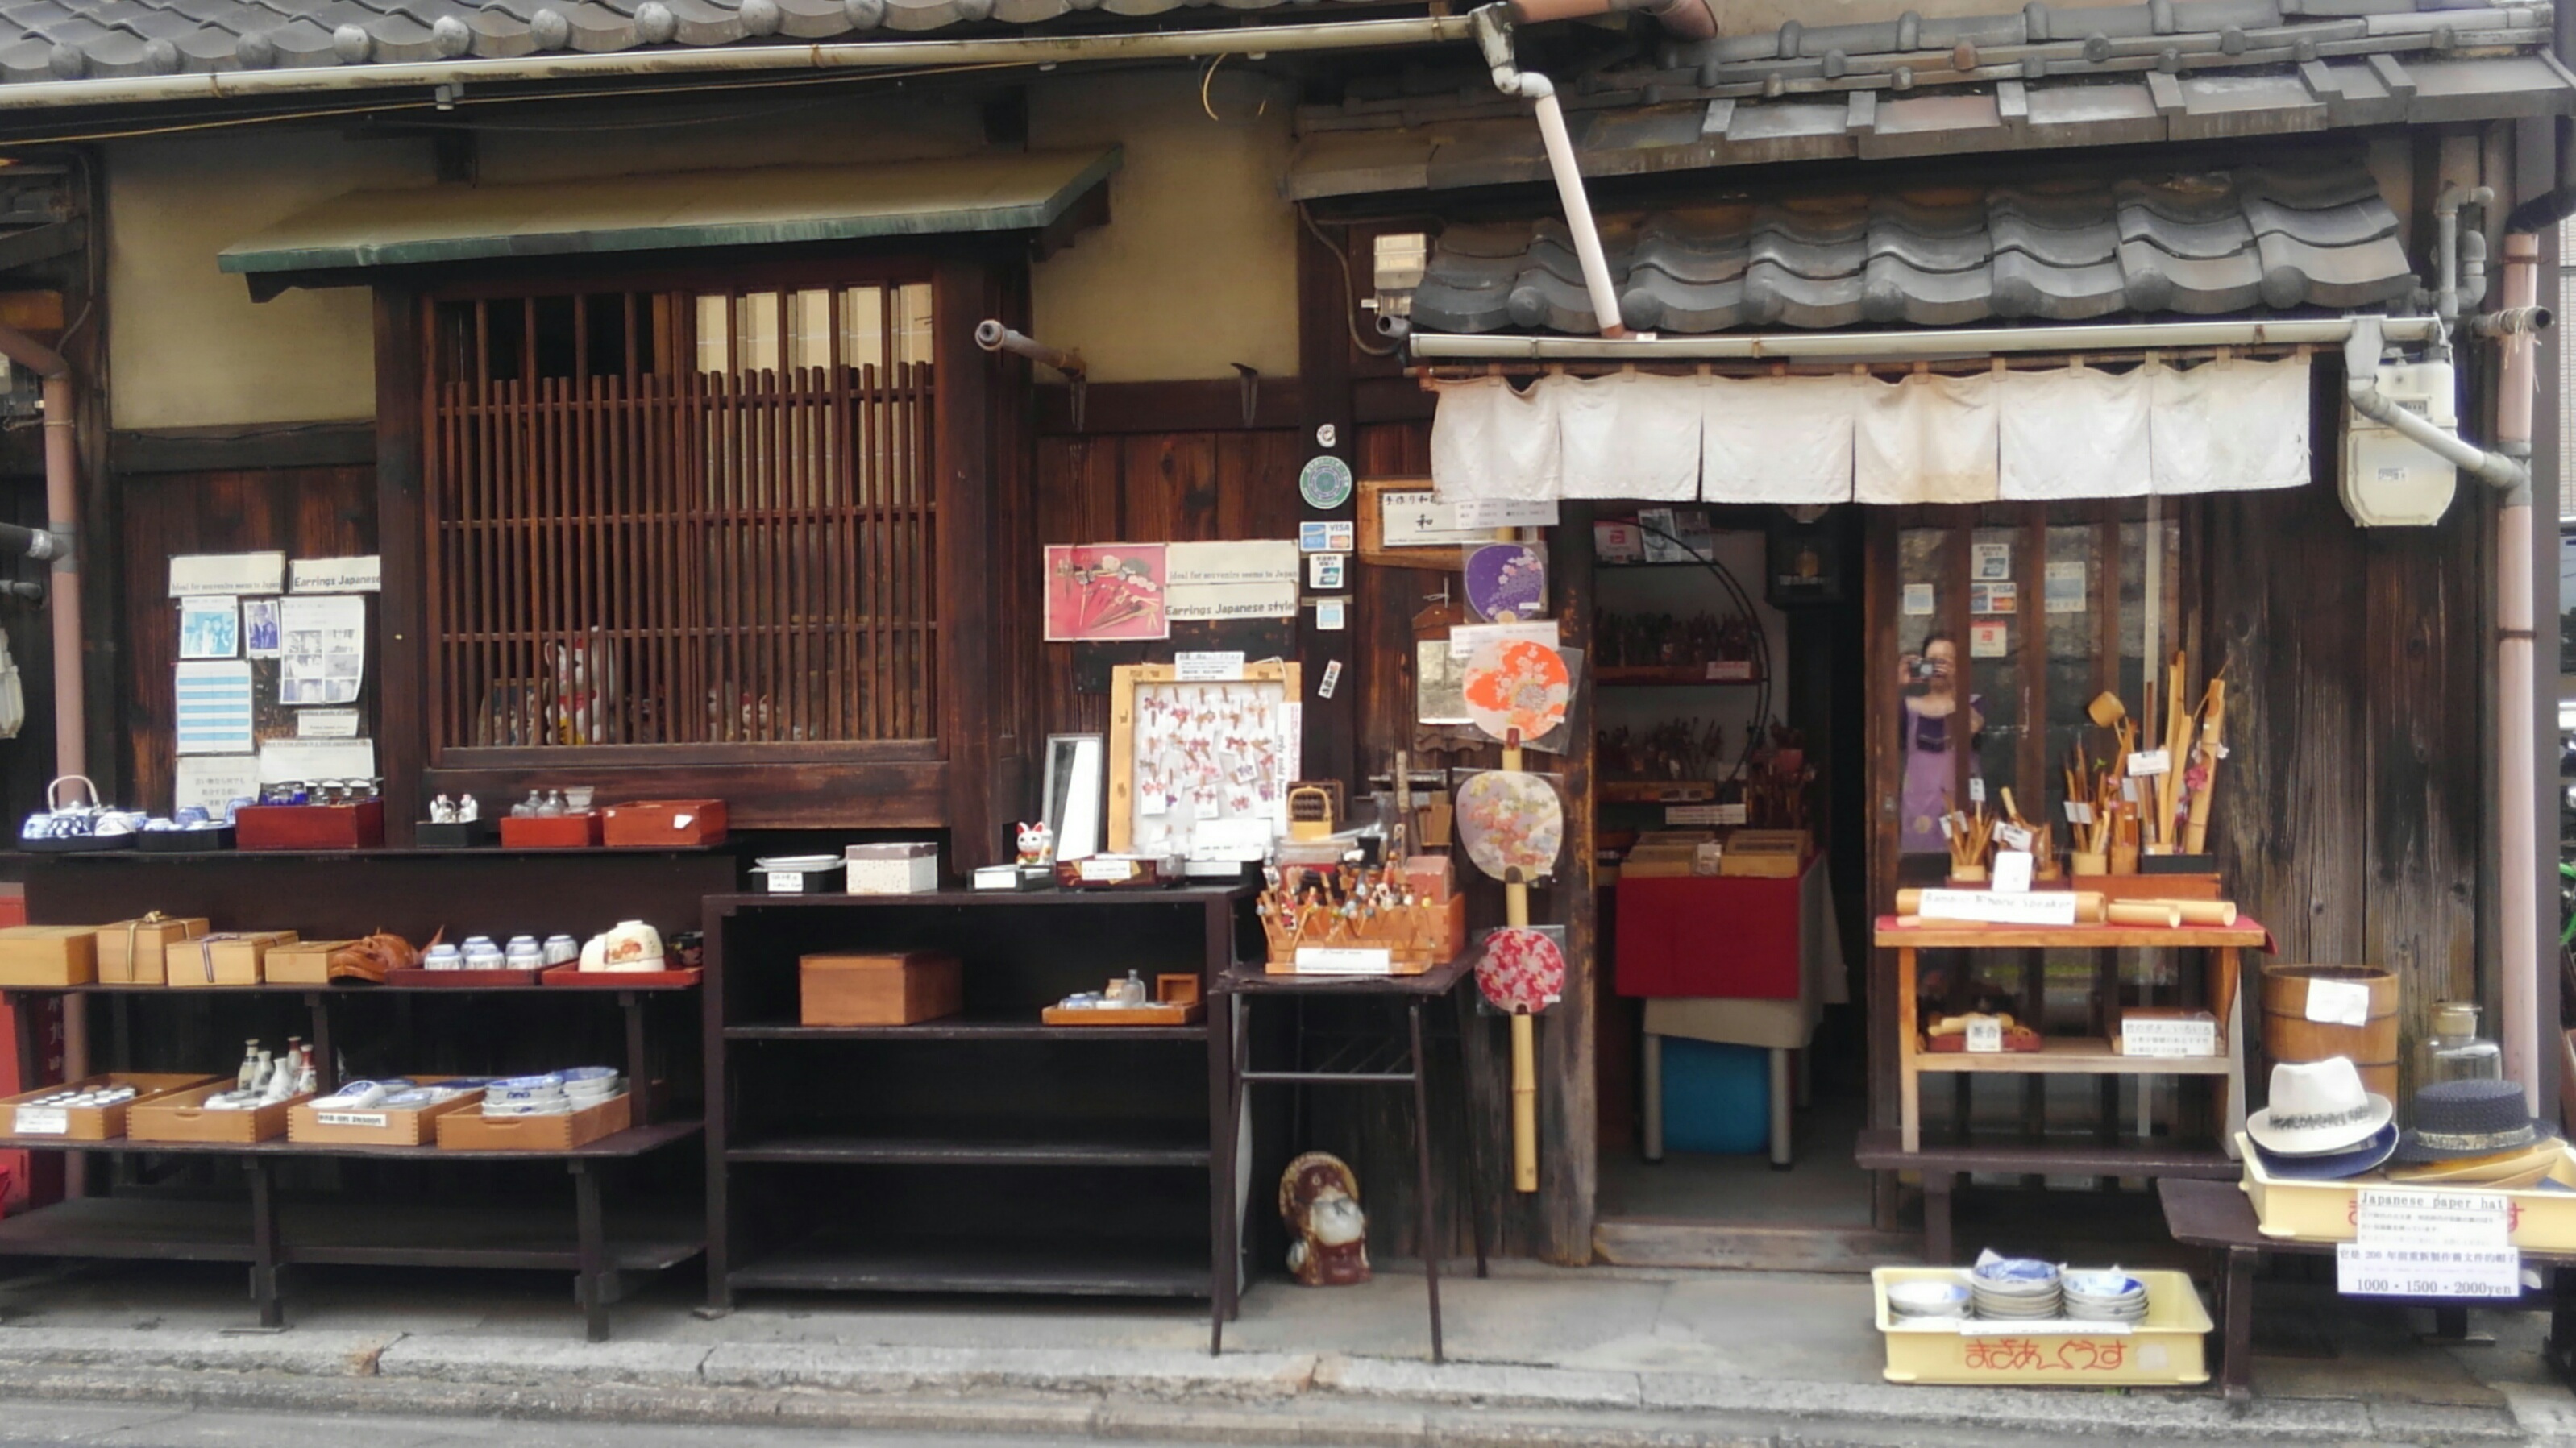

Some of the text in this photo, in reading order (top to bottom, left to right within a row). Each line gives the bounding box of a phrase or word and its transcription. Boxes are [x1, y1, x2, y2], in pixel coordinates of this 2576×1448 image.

[294, 577, 335, 587] Earrings
[1275, 570, 1297, 579] Japan
[193, 582, 202, 590] for
[1165, 600, 1294, 616] Earrings Japanese style
[1277, 735, 1286, 753] only
[1277, 757, 1285, 775] sold
[2362, 1192, 2504, 1210] Japanese paper hat
